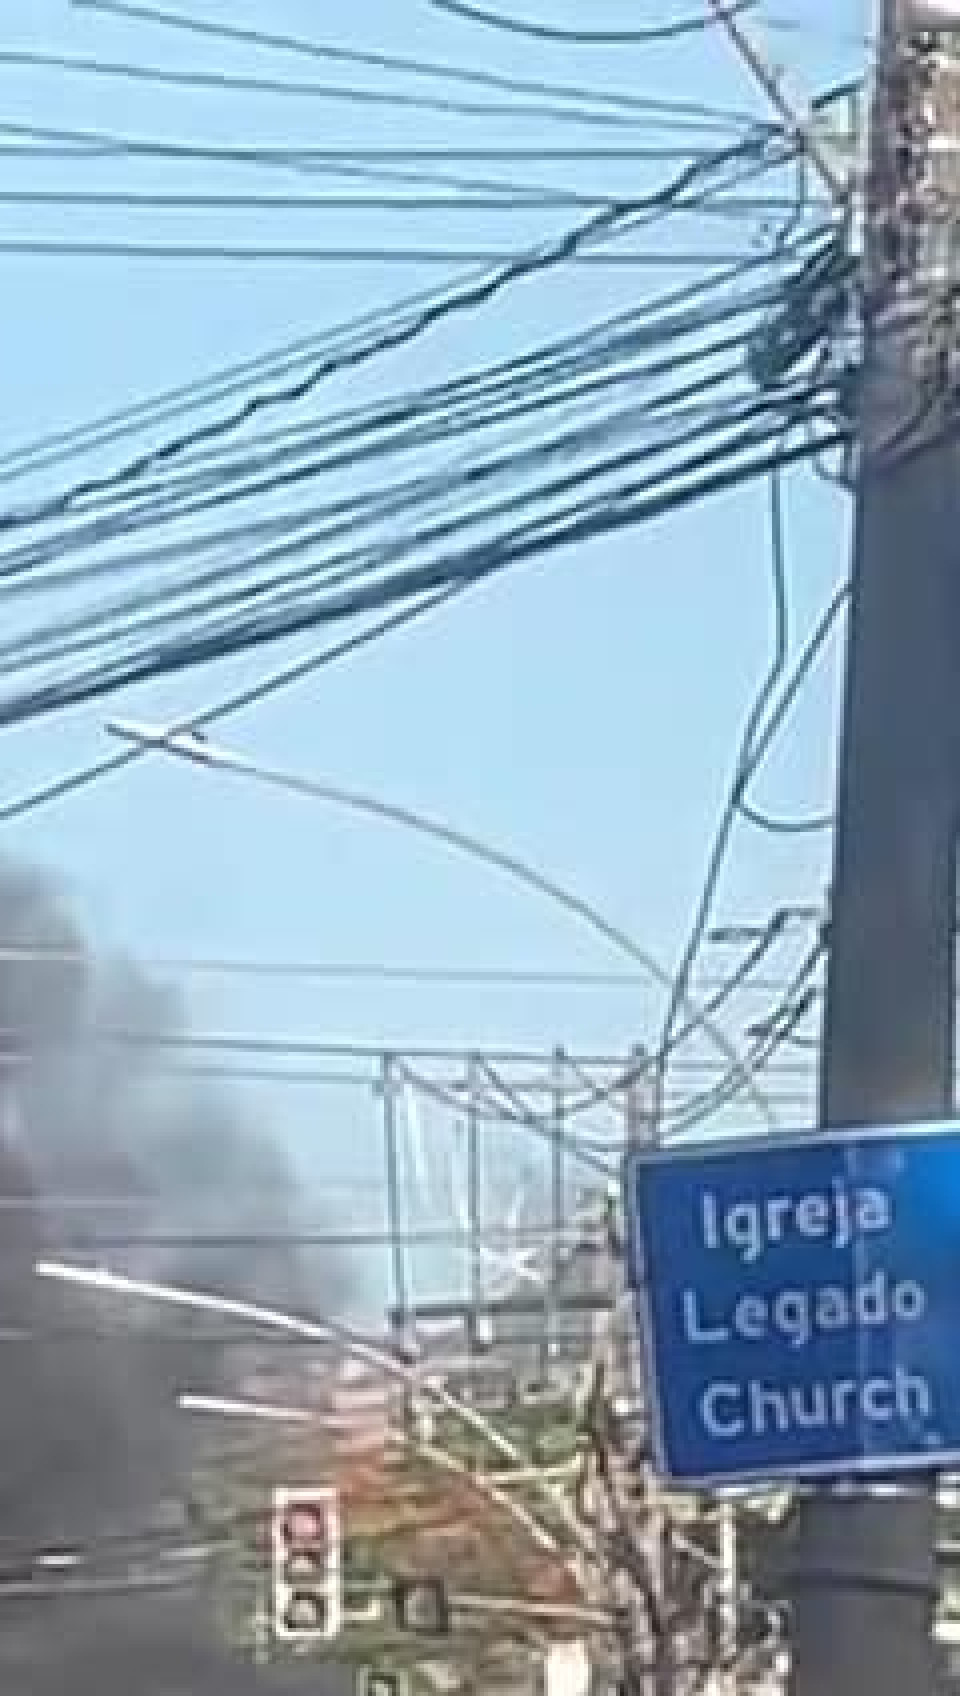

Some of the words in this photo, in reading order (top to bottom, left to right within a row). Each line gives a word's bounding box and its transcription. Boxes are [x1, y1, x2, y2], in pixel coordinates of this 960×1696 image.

[702, 1177, 891, 1262] Igreja
[682, 1271, 926, 1348] Legado
[700, 1364, 931, 1437] Church
